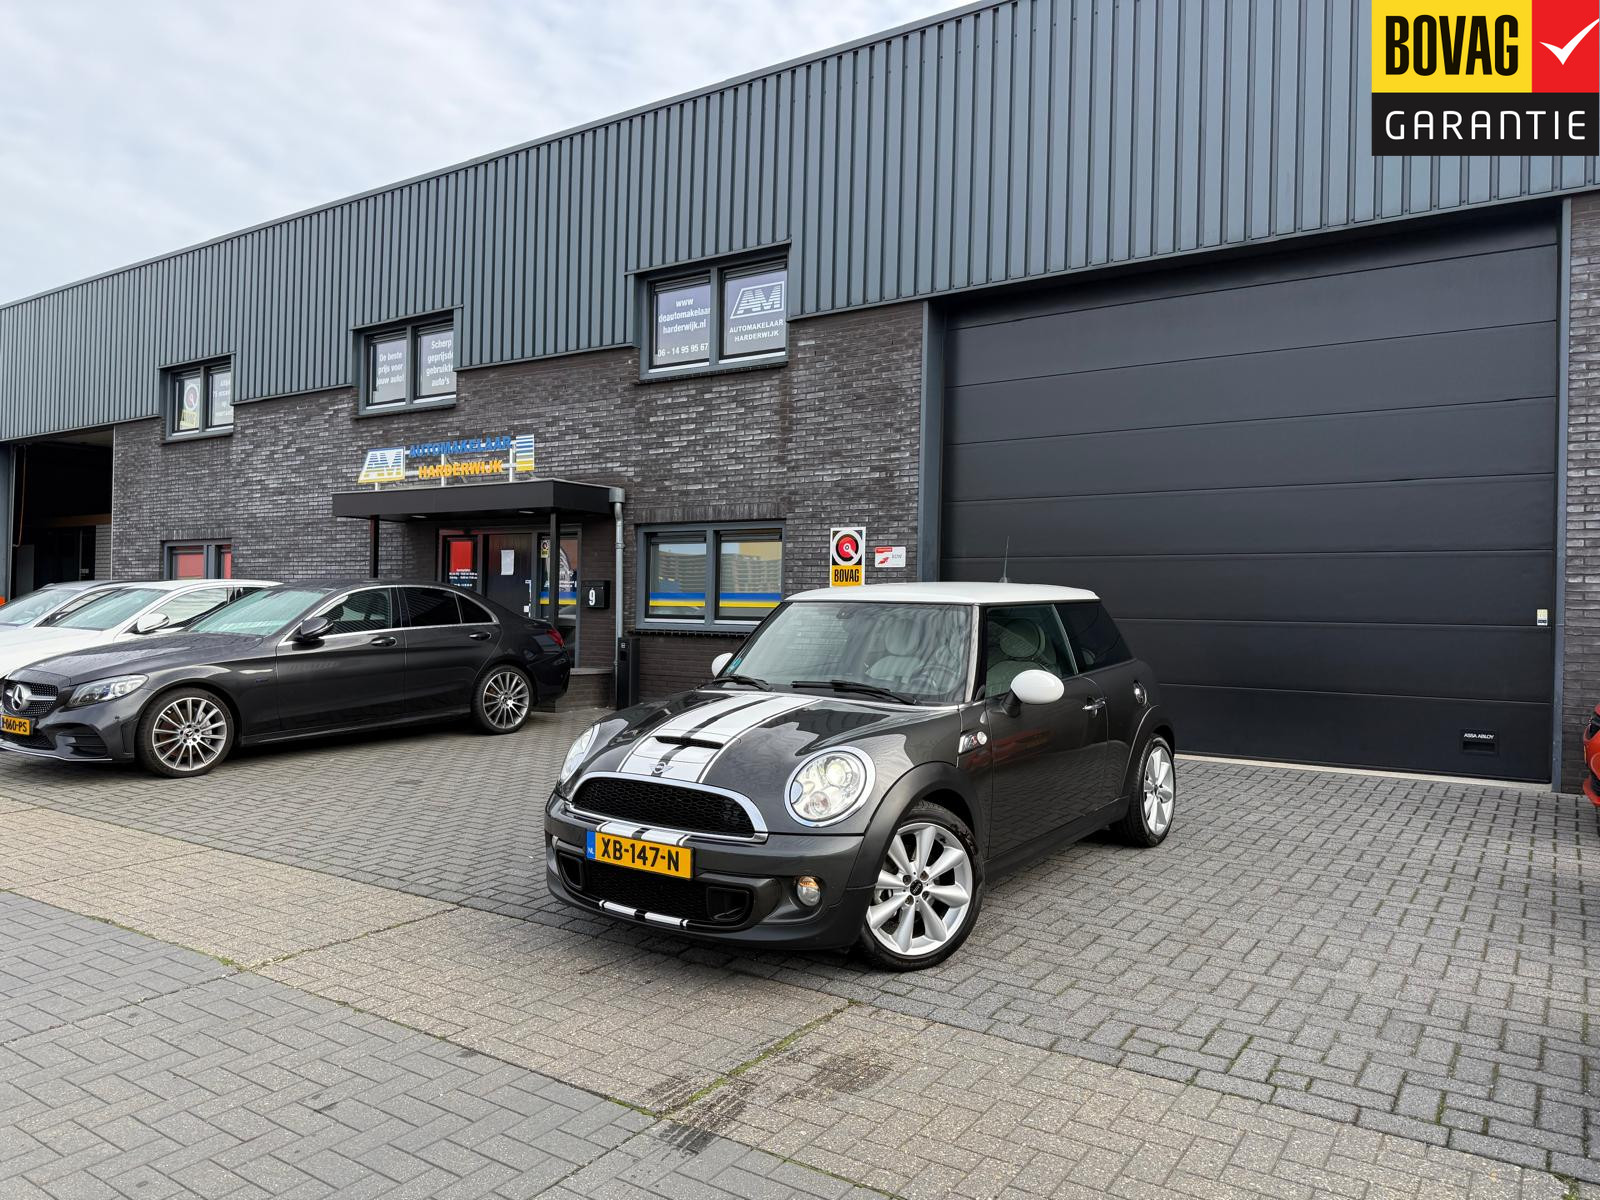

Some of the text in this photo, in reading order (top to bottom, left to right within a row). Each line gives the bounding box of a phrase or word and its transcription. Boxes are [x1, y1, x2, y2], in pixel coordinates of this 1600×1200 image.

[675, 298, 694, 307] www
[663, 319, 707, 334] harderwijk.nl
[729, 319, 784, 333] AUTOMAKELAAR
[734, 330, 780, 342] HARDERWIJK
[431, 339, 452, 349] Scherp
[409, 435, 512, 457] AUTOMAKELAAR
[418, 459, 503, 479] HARDERWIJK
[834, 568, 860, 583] BOVAG
[588, 589, 596, 606] 9
[587, 836, 680, 872] NL XB-147-N
